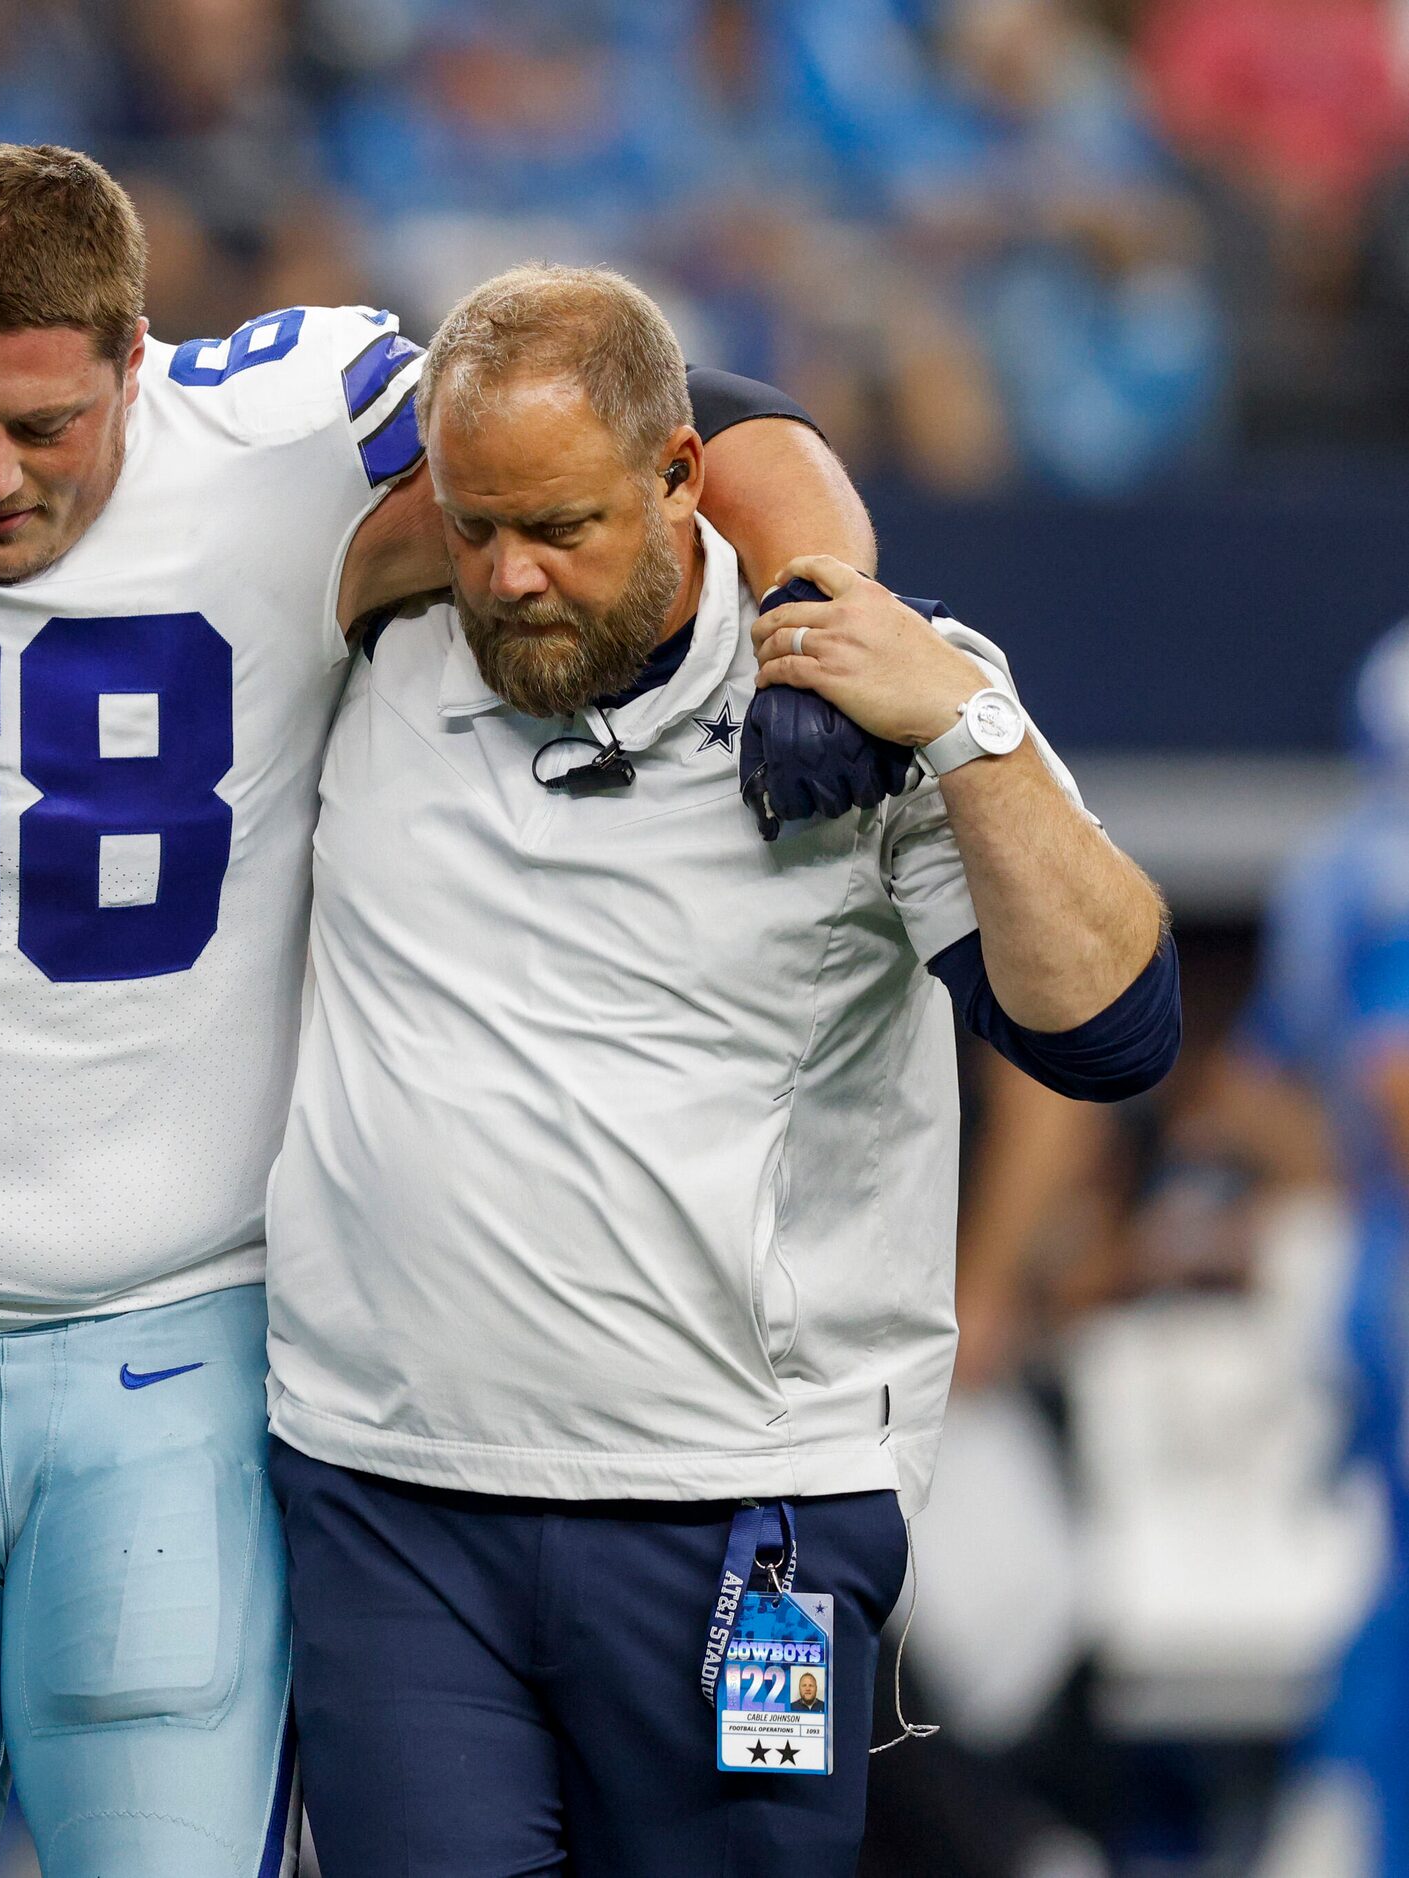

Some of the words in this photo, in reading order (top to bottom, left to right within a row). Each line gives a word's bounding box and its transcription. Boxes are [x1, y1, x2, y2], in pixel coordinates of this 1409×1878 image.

[715, 1570, 743, 1625] AT&T
[700, 1626, 730, 1708] STADIU
[728, 1725, 758, 1733] FOOTBALL
[758, 1726, 794, 1734] OPERATIONS
[746, 1713, 768, 1722] CABLE
[769, 1714, 801, 1723] JOHNSON
